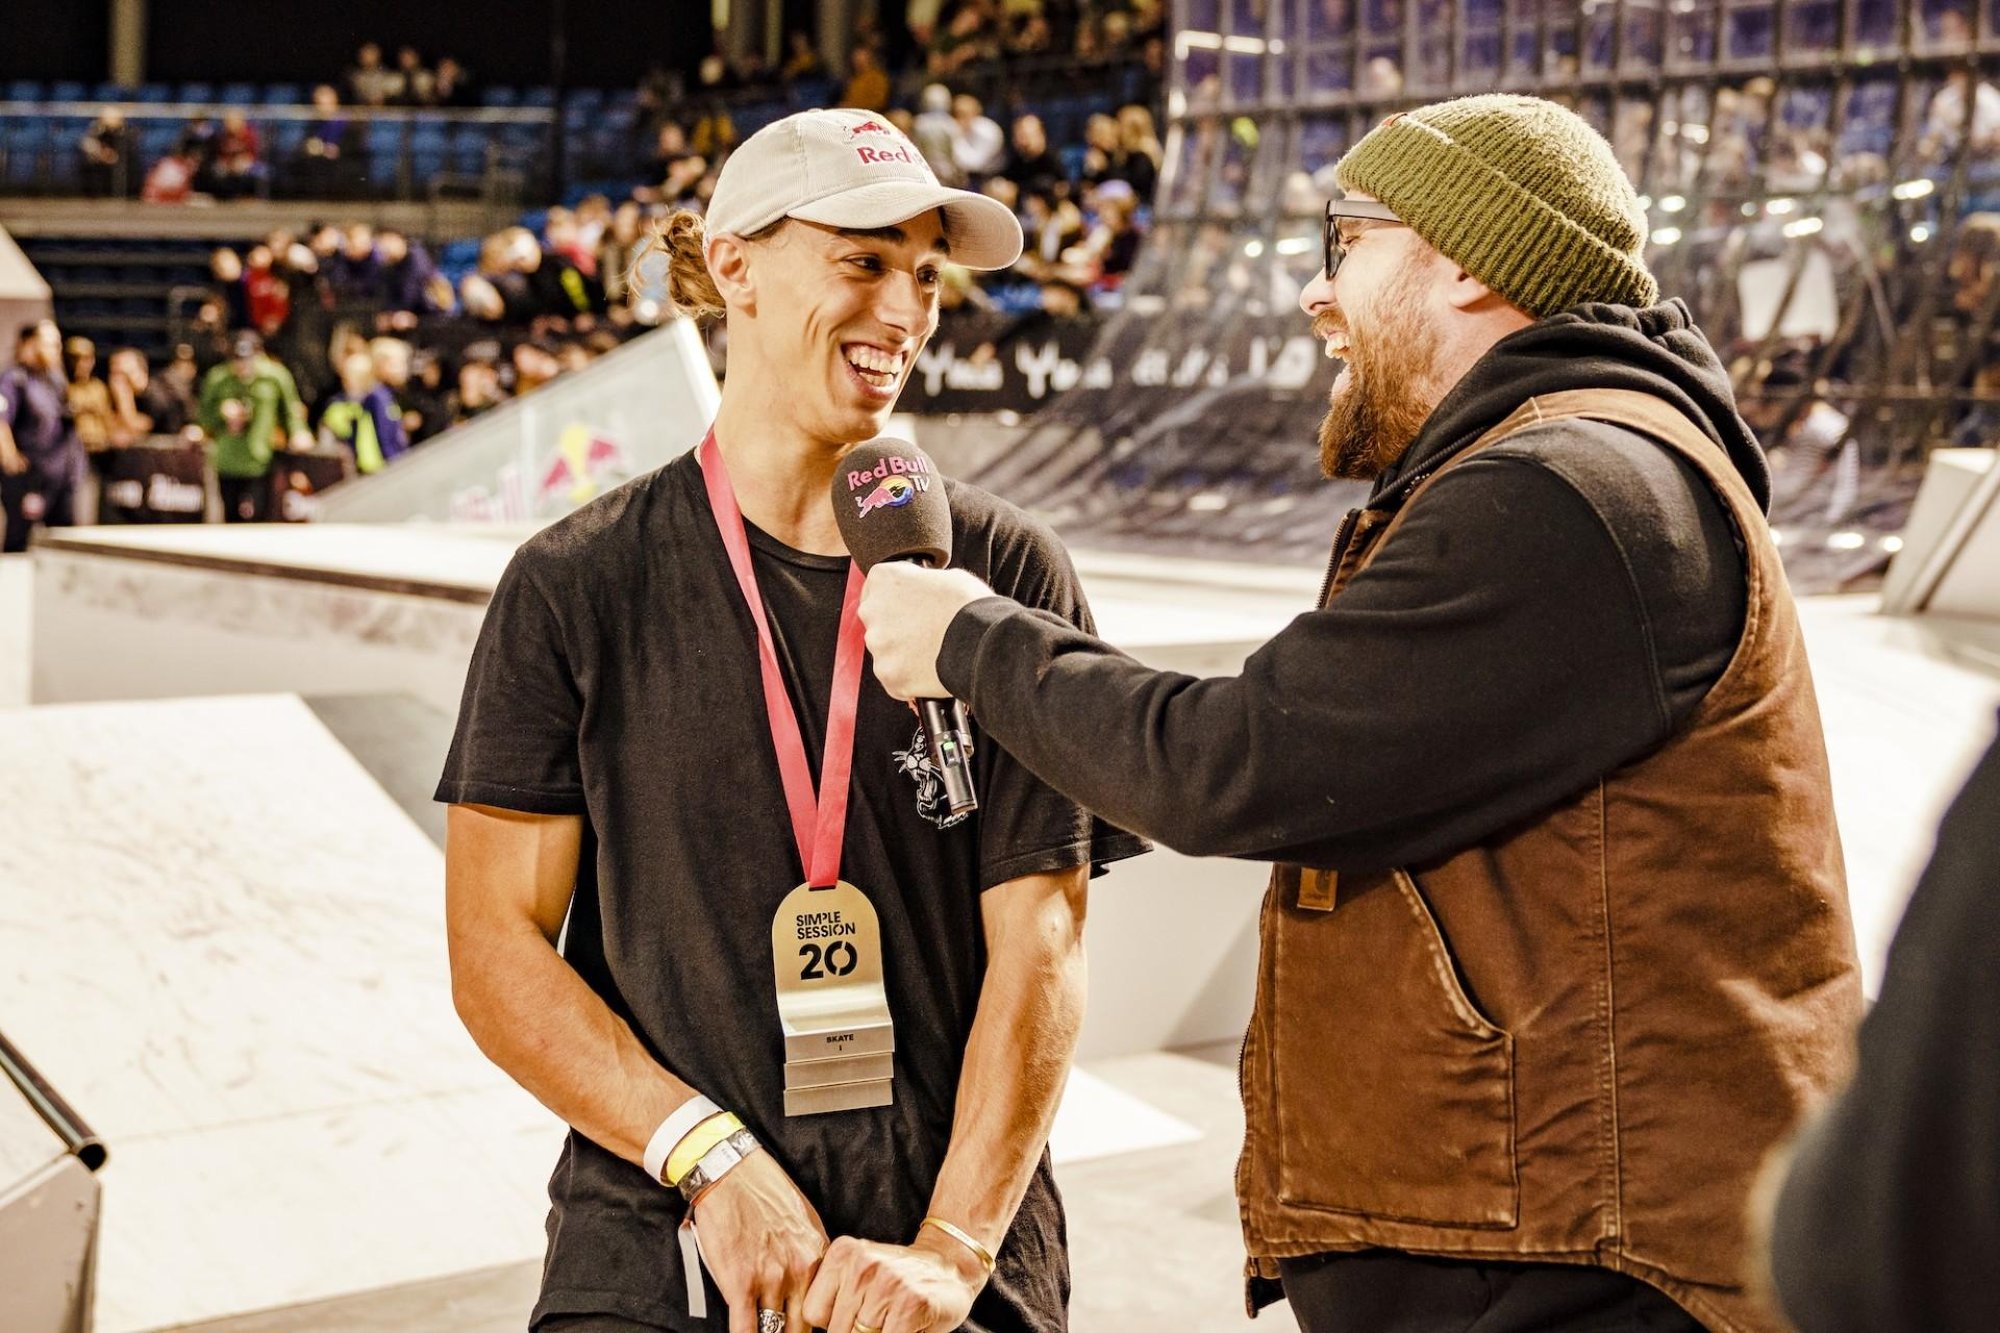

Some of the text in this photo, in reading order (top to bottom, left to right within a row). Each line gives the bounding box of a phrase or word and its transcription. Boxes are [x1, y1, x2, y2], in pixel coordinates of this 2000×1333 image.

[857, 145, 912, 165] Red
[847, 455, 929, 491] Red Bull
[908, 474, 930, 492] TV
[796, 911, 841, 927] SIMPLE
[797, 921, 856, 940] SESSION
[799, 940, 858, 980] 20
[826, 1033, 854, 1043] SKATE
